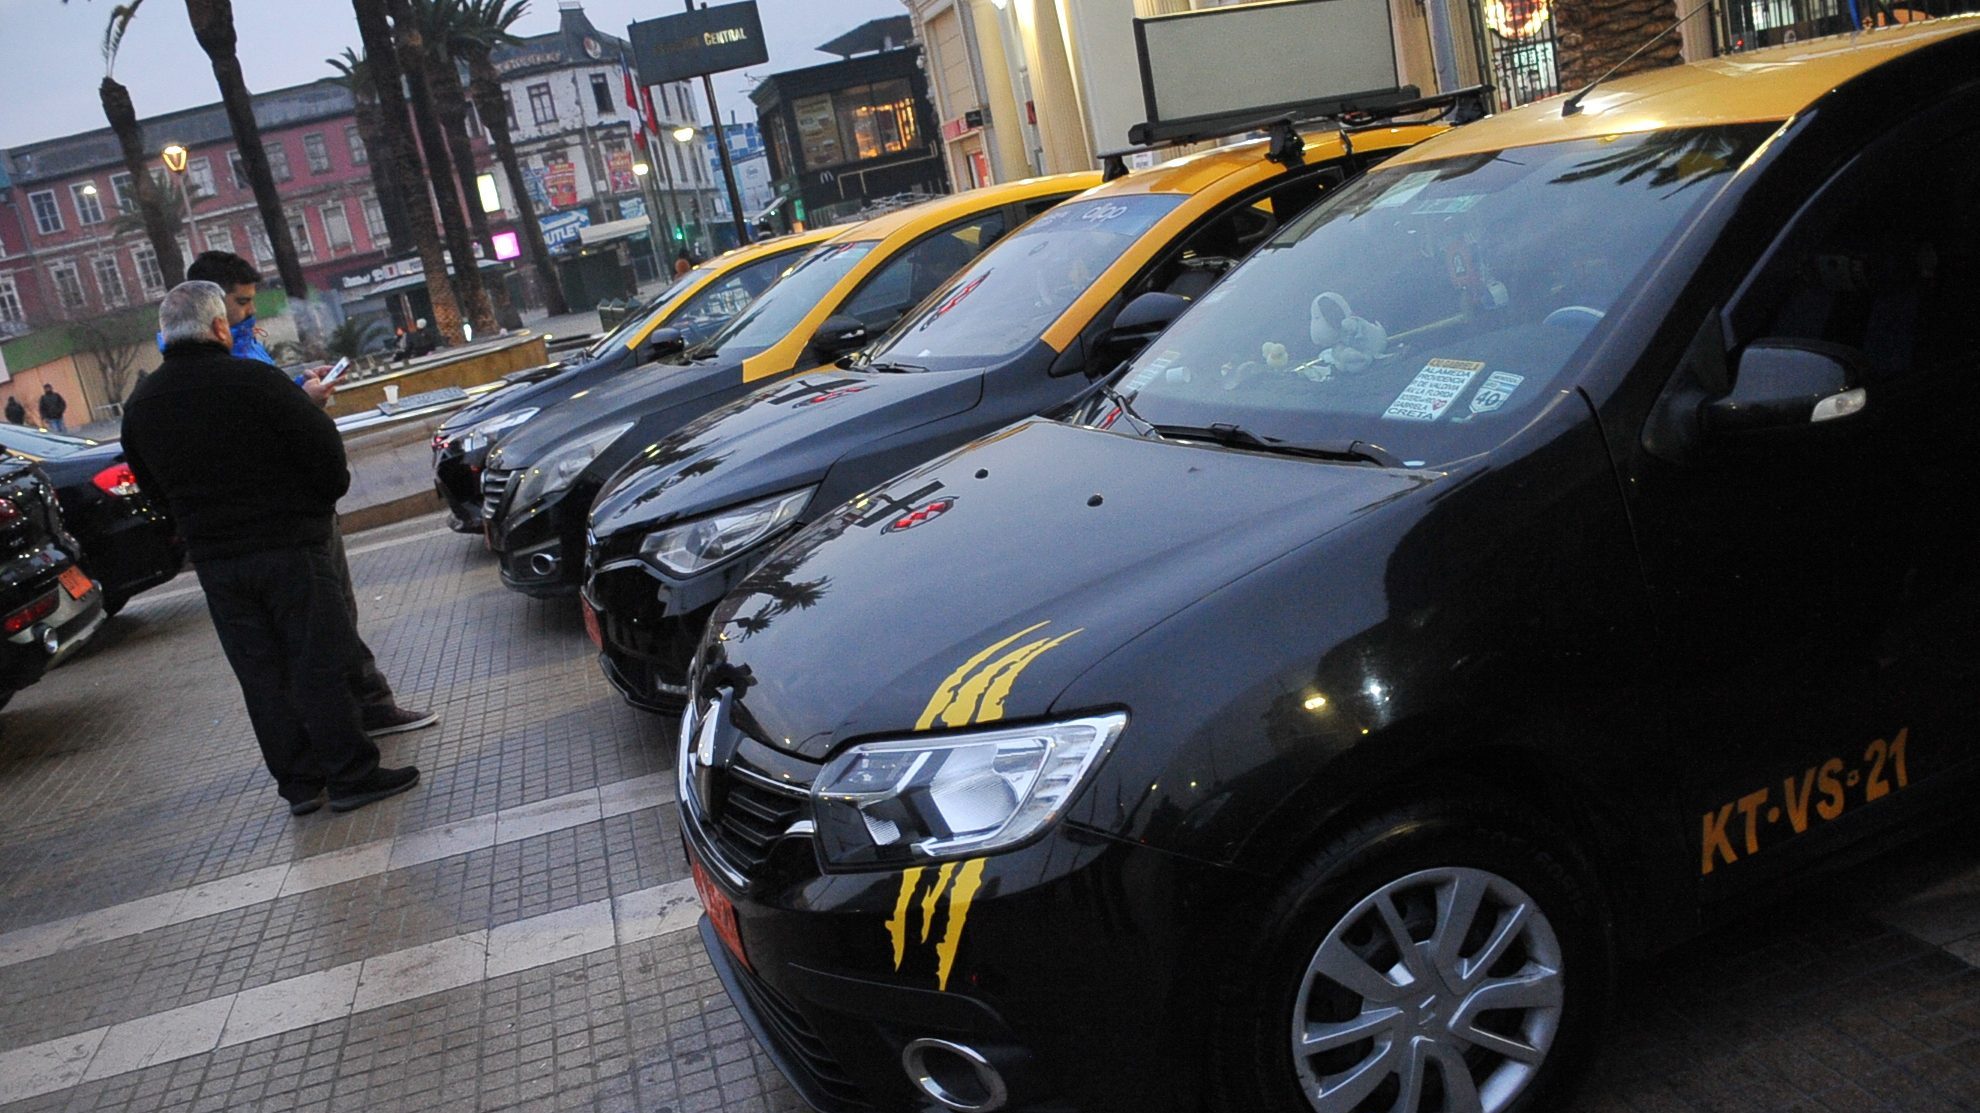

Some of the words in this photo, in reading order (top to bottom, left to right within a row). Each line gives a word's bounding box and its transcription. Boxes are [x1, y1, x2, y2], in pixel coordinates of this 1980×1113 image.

[703, 27, 747, 46] CENTRAL
[1423, 367, 1471, 377] ALAMEDA
[1475, 391, 1501, 406] 40
[1387, 407, 1433, 420] CRETA
